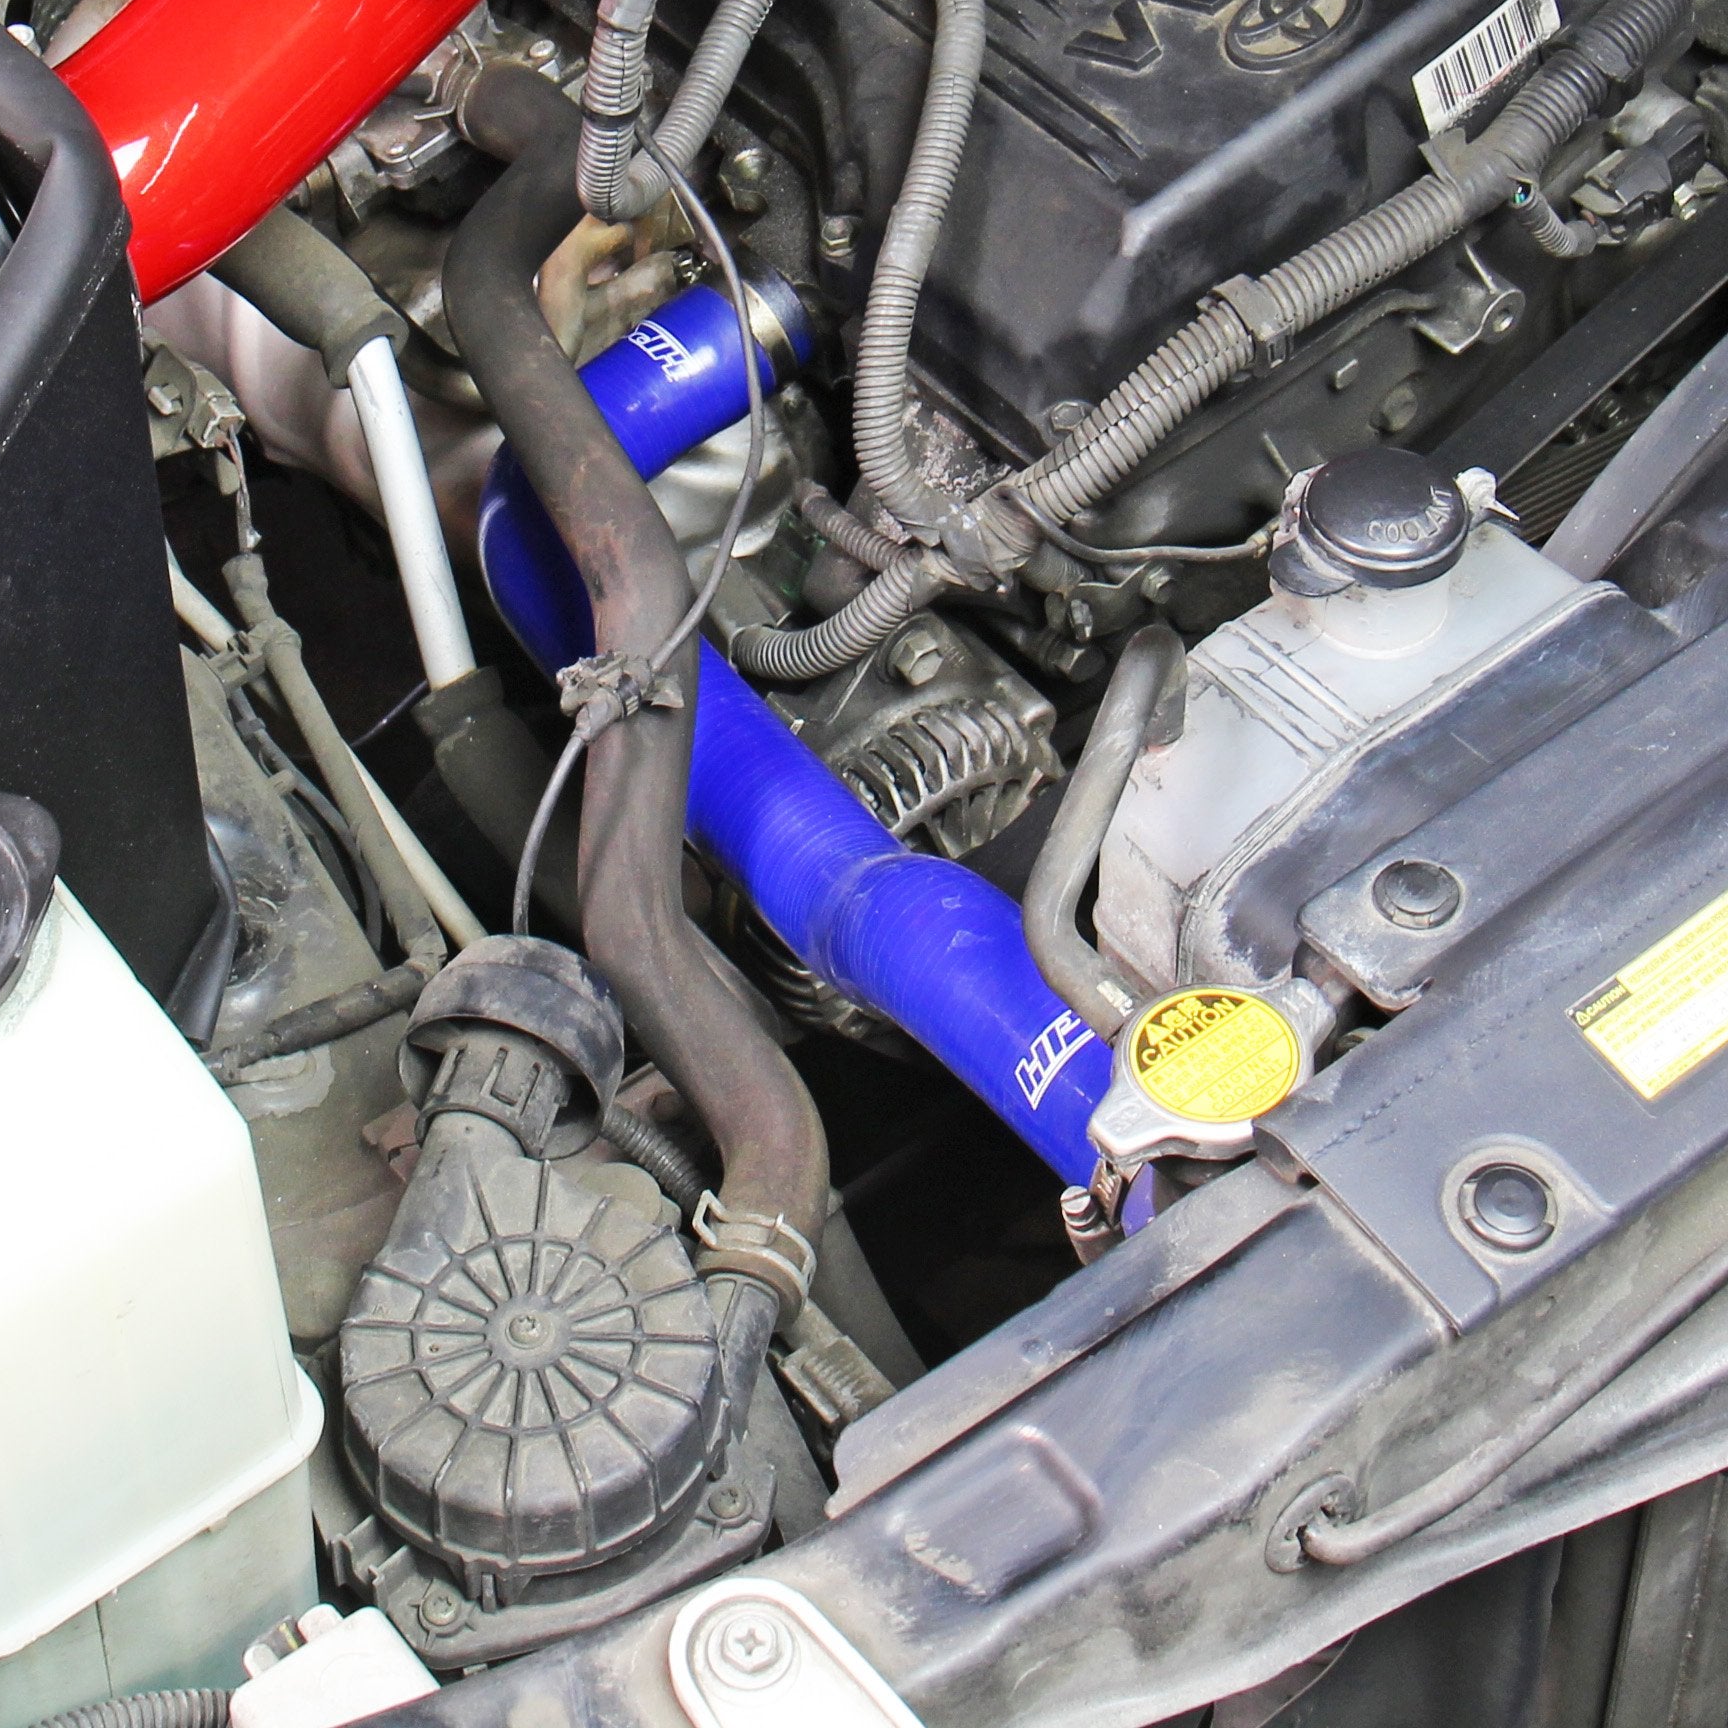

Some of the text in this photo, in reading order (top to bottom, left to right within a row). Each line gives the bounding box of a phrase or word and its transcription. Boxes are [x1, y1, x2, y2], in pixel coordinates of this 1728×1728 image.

[1367, 484, 1453, 544] COOLANT
[1586, 984, 1627, 1018] CAUTION
[1141, 996, 1237, 1067] CAUTION
[1207, 1054, 1272, 1100] ENGINE
[1212, 1058, 1285, 1112] COOLANT
